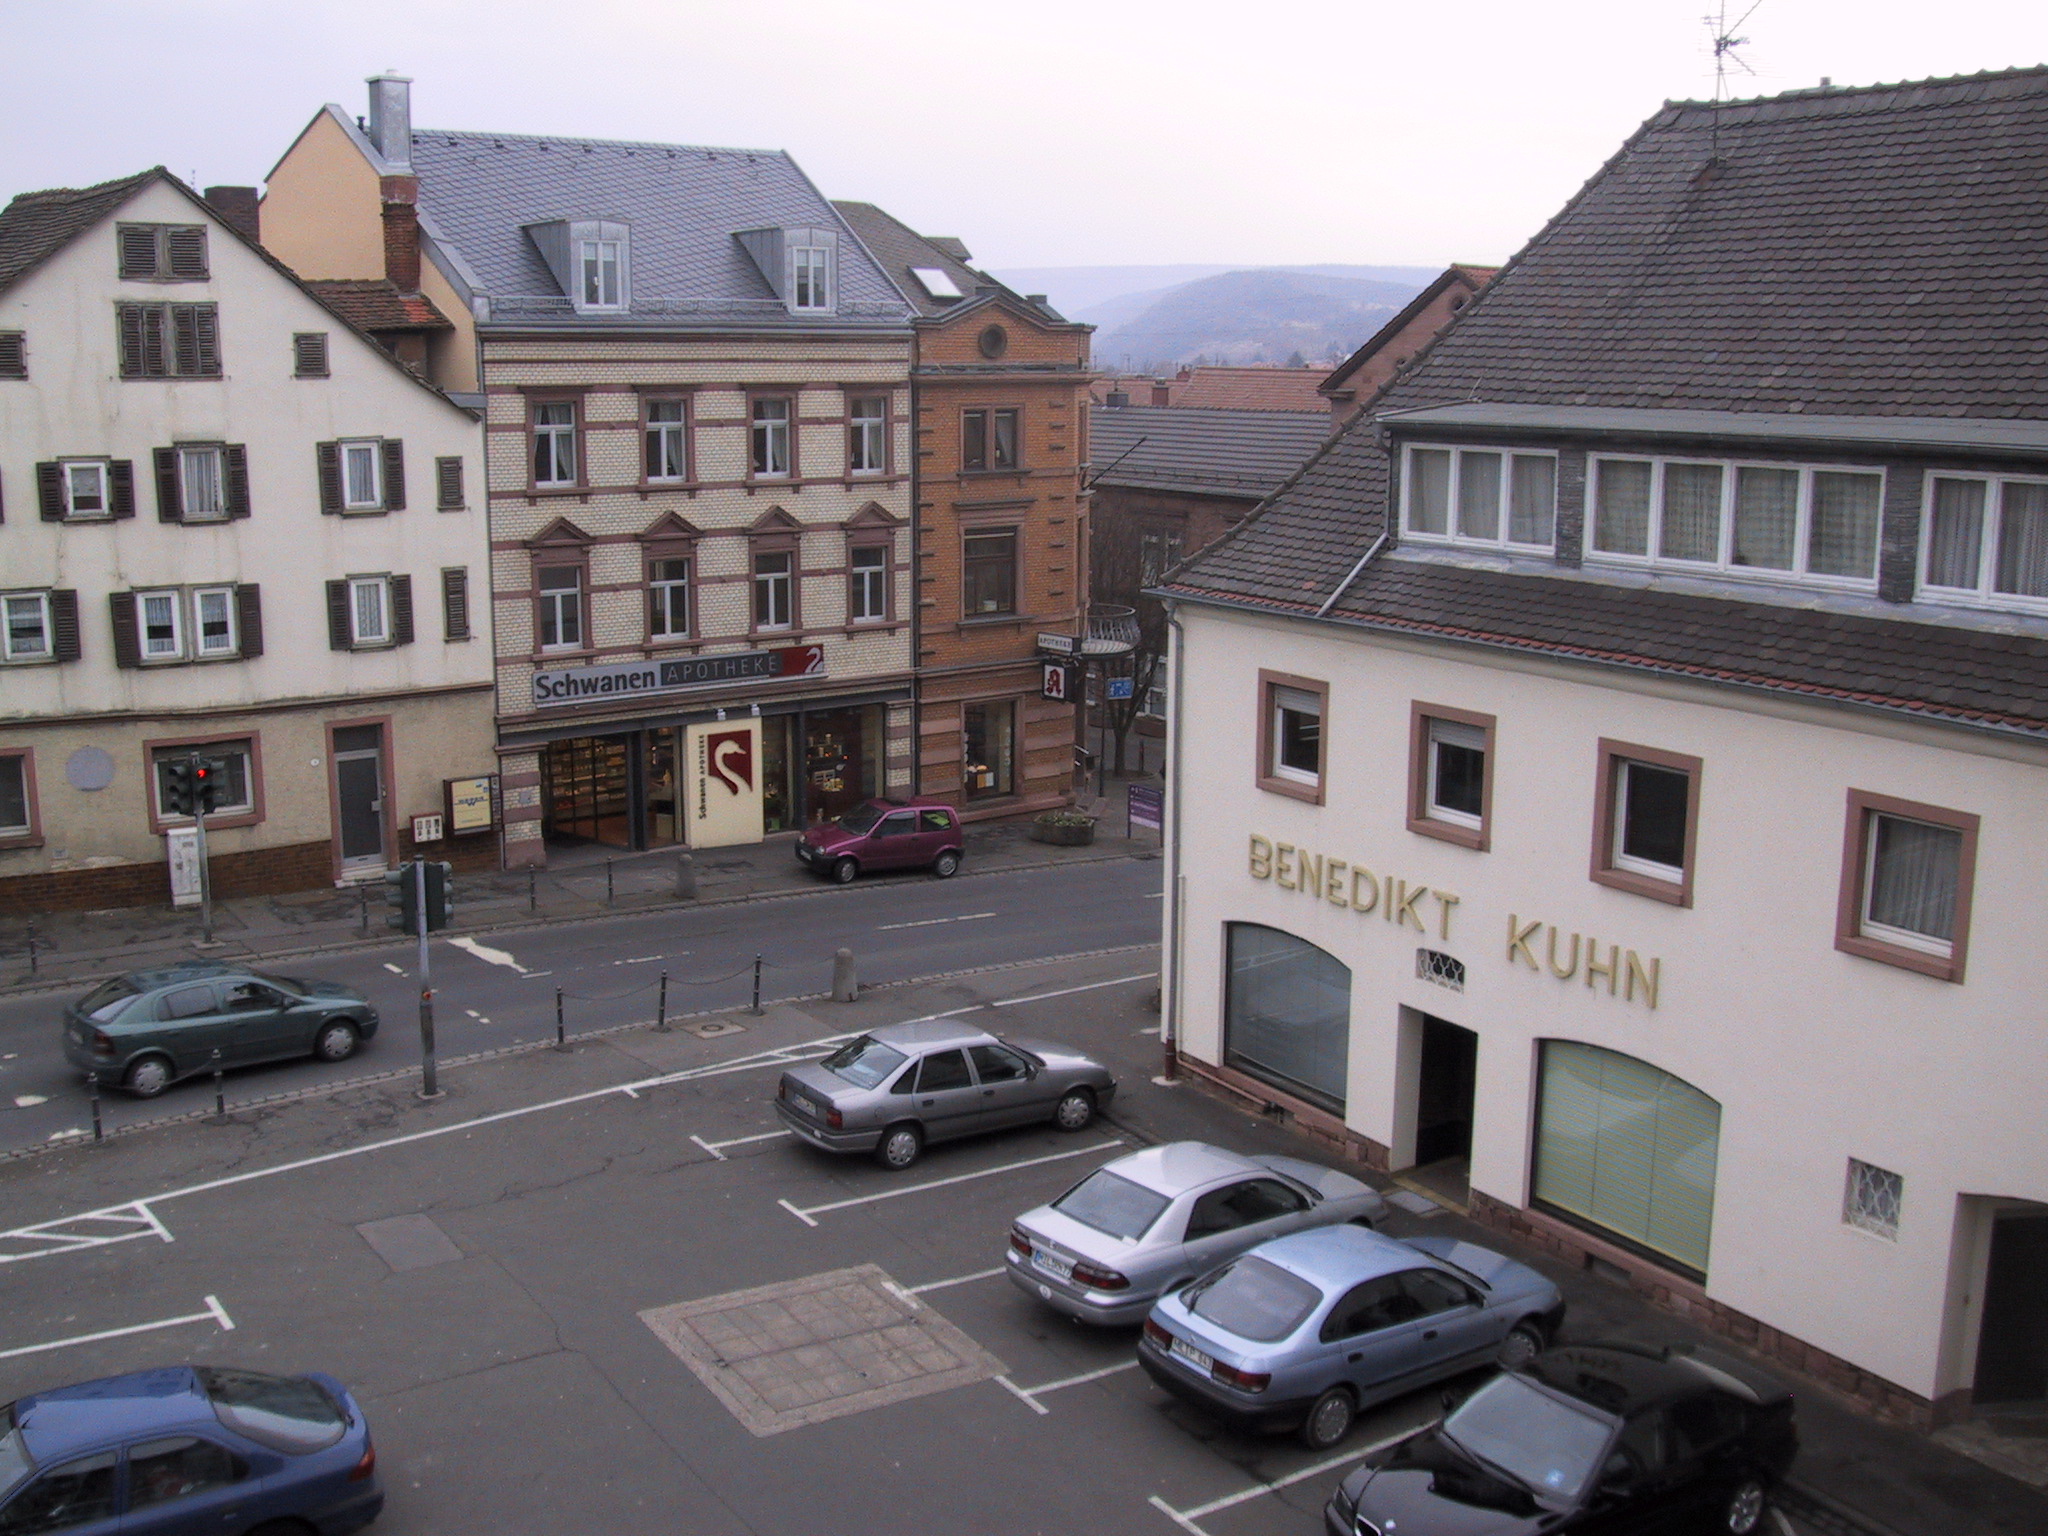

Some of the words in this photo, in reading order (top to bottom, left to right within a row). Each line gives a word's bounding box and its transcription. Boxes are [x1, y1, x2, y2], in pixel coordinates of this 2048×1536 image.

[536, 671, 656, 700] Schwanen
[666, 655, 777, 682] APOTHEKE
[699, 778, 707, 820] Schwanen
[1248, 833, 1460, 941] BENEDIKT
[1506, 913, 1661, 1009] KUHN
